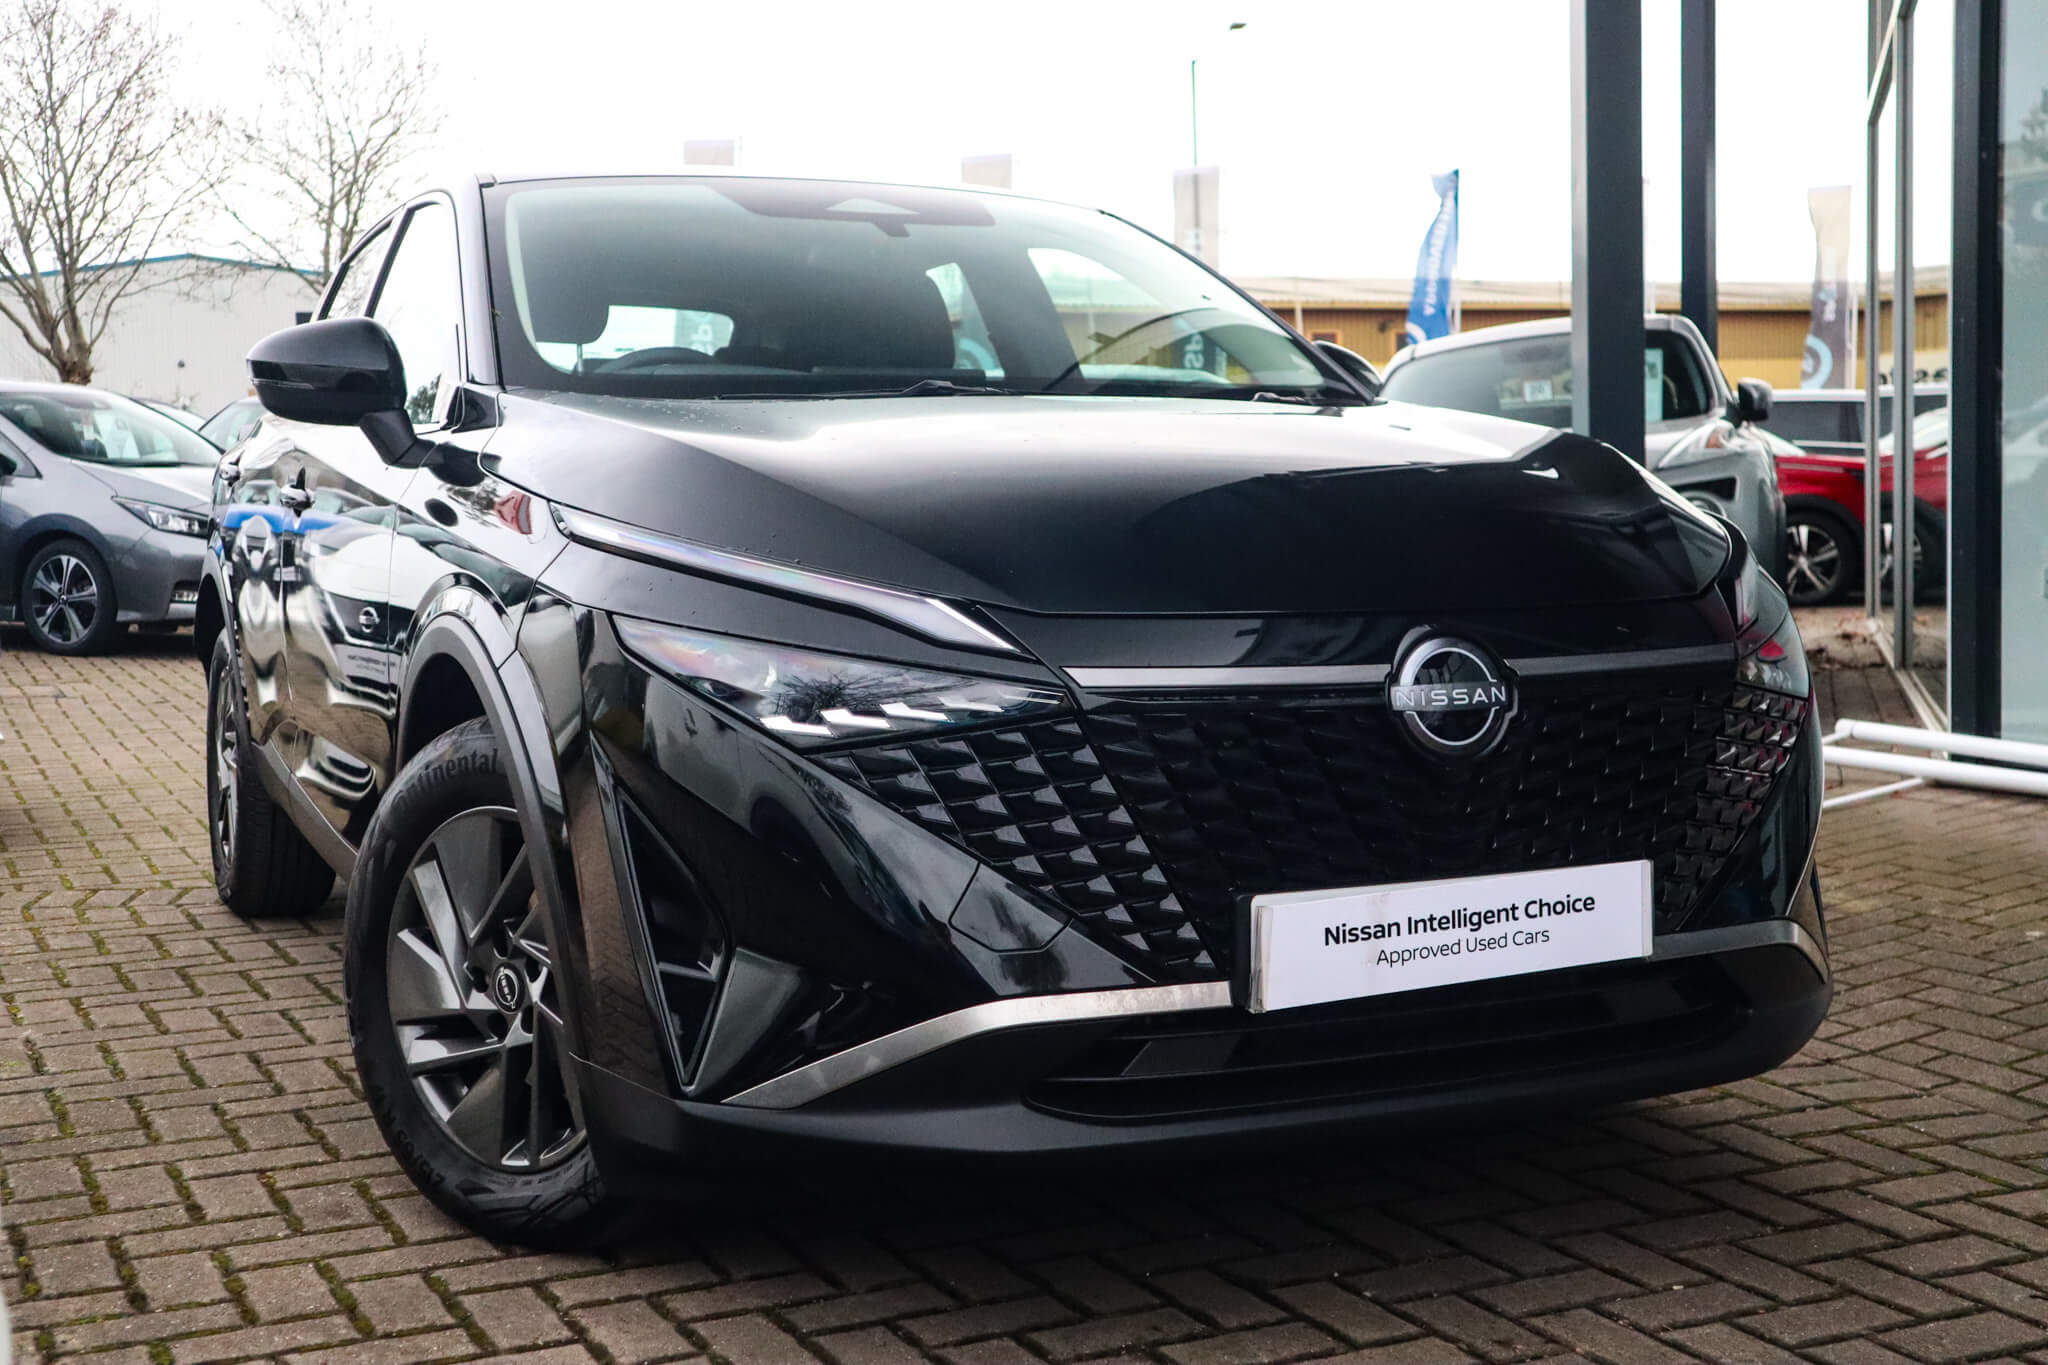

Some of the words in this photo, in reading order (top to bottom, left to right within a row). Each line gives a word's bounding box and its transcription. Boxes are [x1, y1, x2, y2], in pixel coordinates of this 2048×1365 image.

[1395, 685, 1506, 706] NISSAN
[1324, 923, 1401, 946] Nissan
[1407, 902, 1519, 936] Intelligent
[1524, 894, 1596, 919] Choice
[1376, 938, 1461, 968] Approved
[1466, 931, 1508, 953] Used
[1512, 929, 1550, 946] Cars
